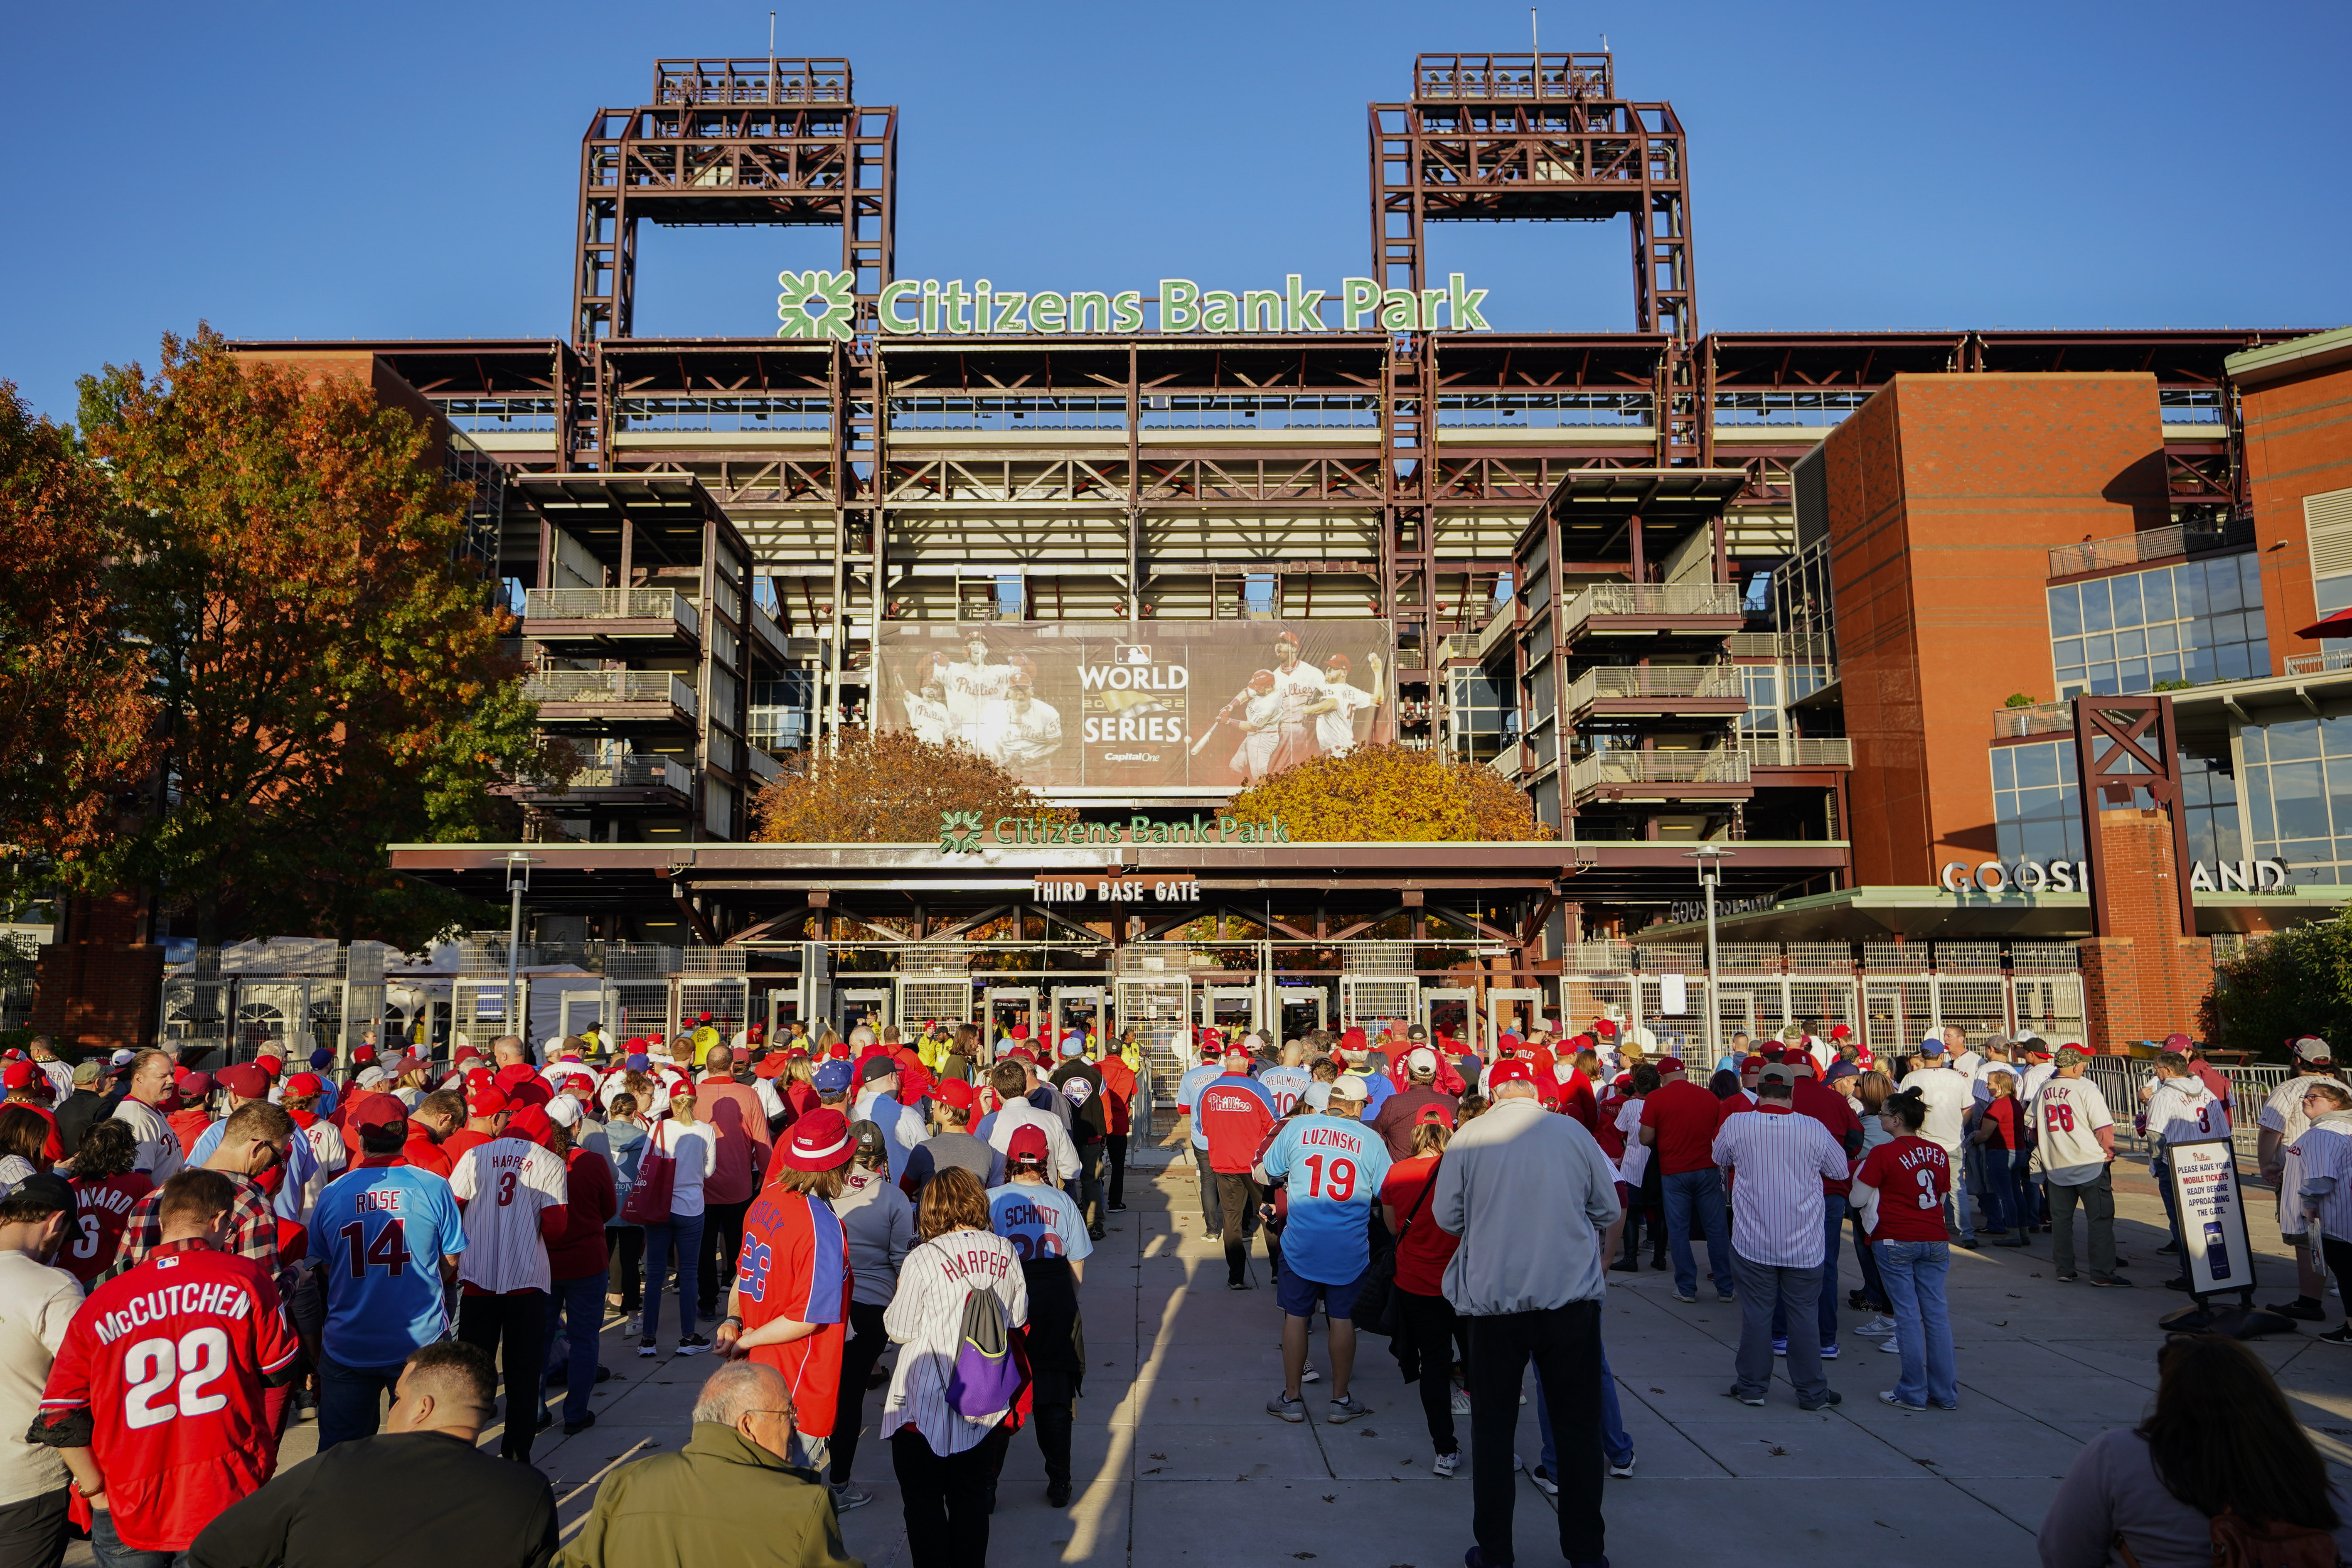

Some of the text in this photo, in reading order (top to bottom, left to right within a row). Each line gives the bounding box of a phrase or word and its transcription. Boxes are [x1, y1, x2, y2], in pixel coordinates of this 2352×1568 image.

[878, 273, 1491, 334] Citizens Bank Park
[957, 677, 997, 696] Phillies
[1076, 665, 1188, 690] WORLD
[1282, 683, 1313, 698] illies
[1082, 699, 1184, 708] 20 22
[1083, 717, 1183, 742] SERIES
[993, 813, 1289, 844] Citizens Bank Park
[2190, 860, 2286, 892] AND
[1031, 881, 1200, 902] THIRD BASE GATE
[1671, 901, 1707, 924] GOOS
[1397, 1054, 1407, 1075] WORLD
[1518, 1049, 1535, 1059] UTLEY
[47, 1071, 62, 1081] PER
[550, 1071, 578, 1081] HOW
[1192, 1073, 1220, 1088] HARPE
[1265, 1075, 1306, 1091] REALMUTO
[1067, 1085, 1088, 1094] Phillies
[2043, 1087, 2071, 1100] UTLEY
[1208, 1093, 1252, 1112] Phillies
[2045, 1104, 2074, 1133] 26
[2196, 1107, 2210, 1133] 3
[1302, 1128, 1361, 1155] LUZINSKI
[492, 1155, 533, 1172] HARPER
[1899, 1146, 1946, 1170] HARPER
[2177, 1161, 2231, 1174] PLEASE HAVE YOUR
[2192, 1152, 2211, 1162] Phillies
[1304, 1153, 1357, 1202] 19
[1916, 1168, 1937, 1209] 3
[2183, 1172, 2229, 1185] MOBILE TICKETS
[498, 1172, 517, 1207] 3
[2187, 1184, 2228, 1195] READY BEFORE
[2189, 1194, 2230, 1207] APPROACHING
[355, 1190, 402, 1215] ROSE
[2197, 1207, 2226, 1217] THE GATE.
[750, 1200, 784, 1237] UTLEY
[1005, 1204, 1060, 1229] SCHMIDT
[340, 1217, 412, 1279] 14
[940, 1250, 1008, 1283] HARPER
[95, 1283, 251, 1345] McCUTCHEN
[125, 1327, 229, 1430] 22
